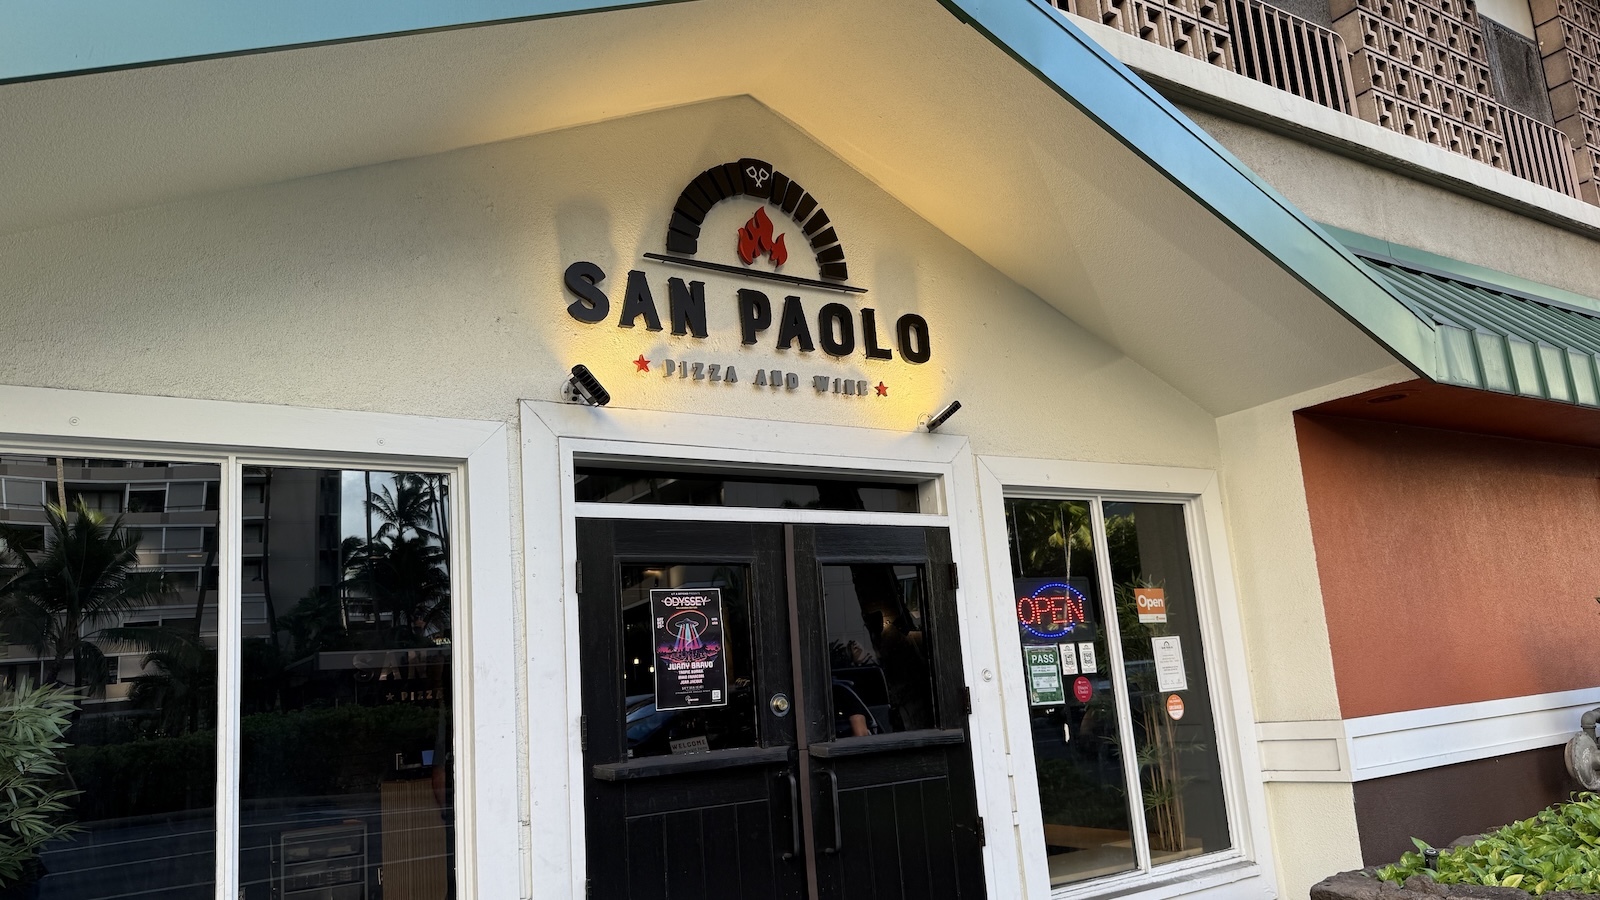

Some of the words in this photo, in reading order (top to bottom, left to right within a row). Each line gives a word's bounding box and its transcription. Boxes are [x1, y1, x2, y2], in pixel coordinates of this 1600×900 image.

[564, 261, 708, 339] SAN
[737, 288, 931, 365] PAOLO
[663, 359, 738, 383] PIZZA
[753, 368, 799, 389] AND
[813, 375, 868, 396] WINE
[664, 596, 707, 607] ODYSSEY
[1138, 594, 1164, 610] Open
[1018, 596, 1085, 625] OPEN
[691, 660, 714, 669] BRAVO
[1031, 654, 1054, 664] PASS
[671, 739, 706, 750] WELCOME
